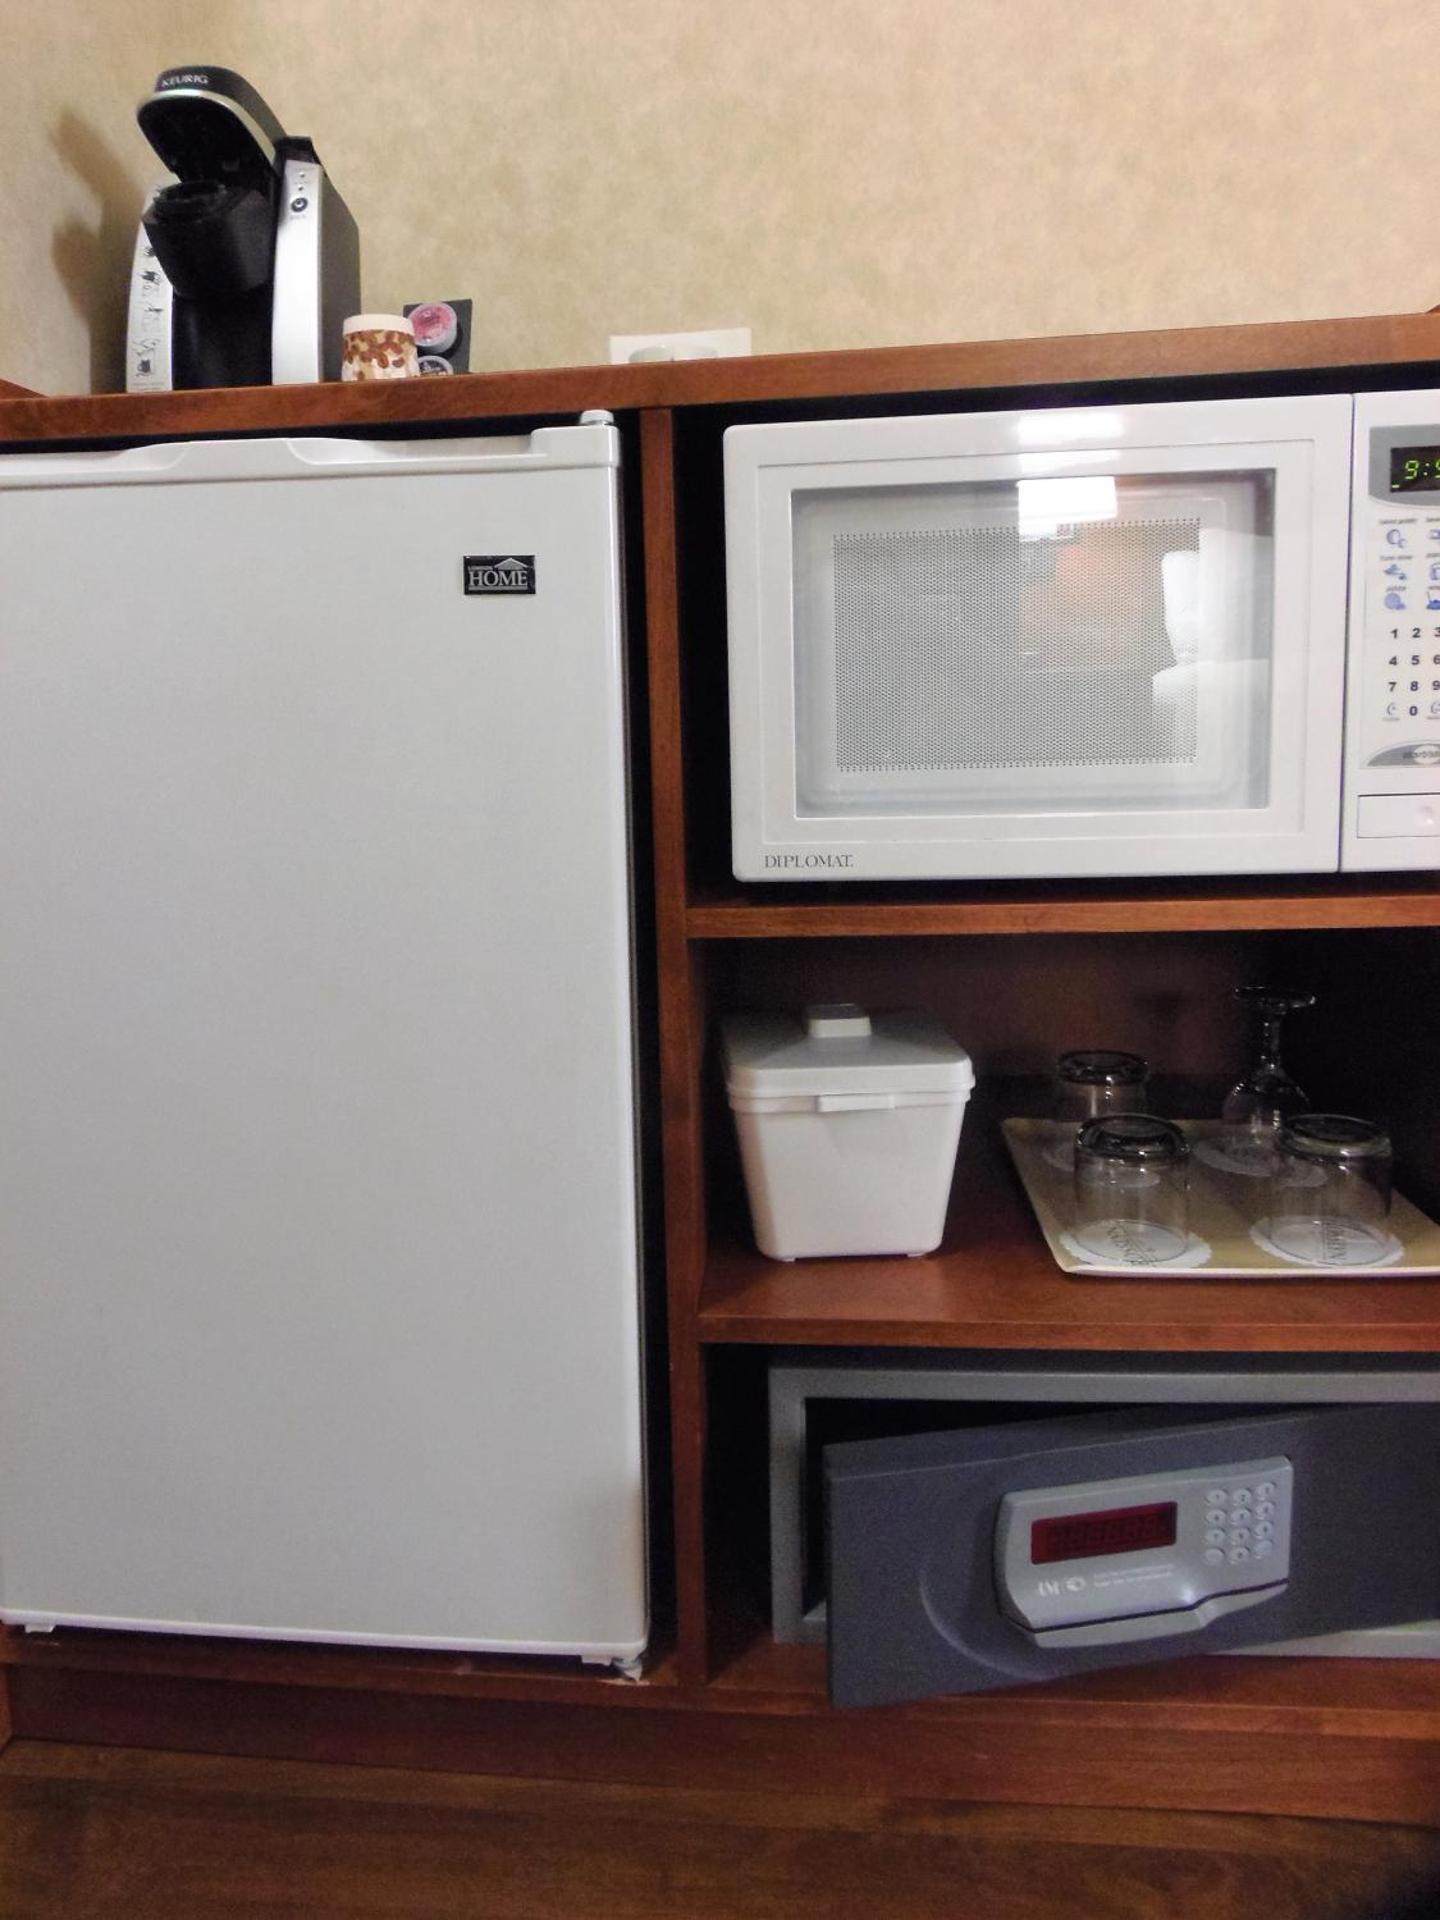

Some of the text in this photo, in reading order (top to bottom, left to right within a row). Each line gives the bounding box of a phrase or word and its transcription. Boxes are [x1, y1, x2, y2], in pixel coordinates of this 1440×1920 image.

[469, 570, 529, 586] HOME
[1391, 628, 1398, 639] 1
[1412, 627, 1421, 638] 2
[1388, 656, 1397, 666] 4
[1411, 655, 1420, 665] 5
[1388, 681, 1397, 692] 7
[1410, 681, 1419, 691] 8
[1409, 706, 1418, 716] 0
